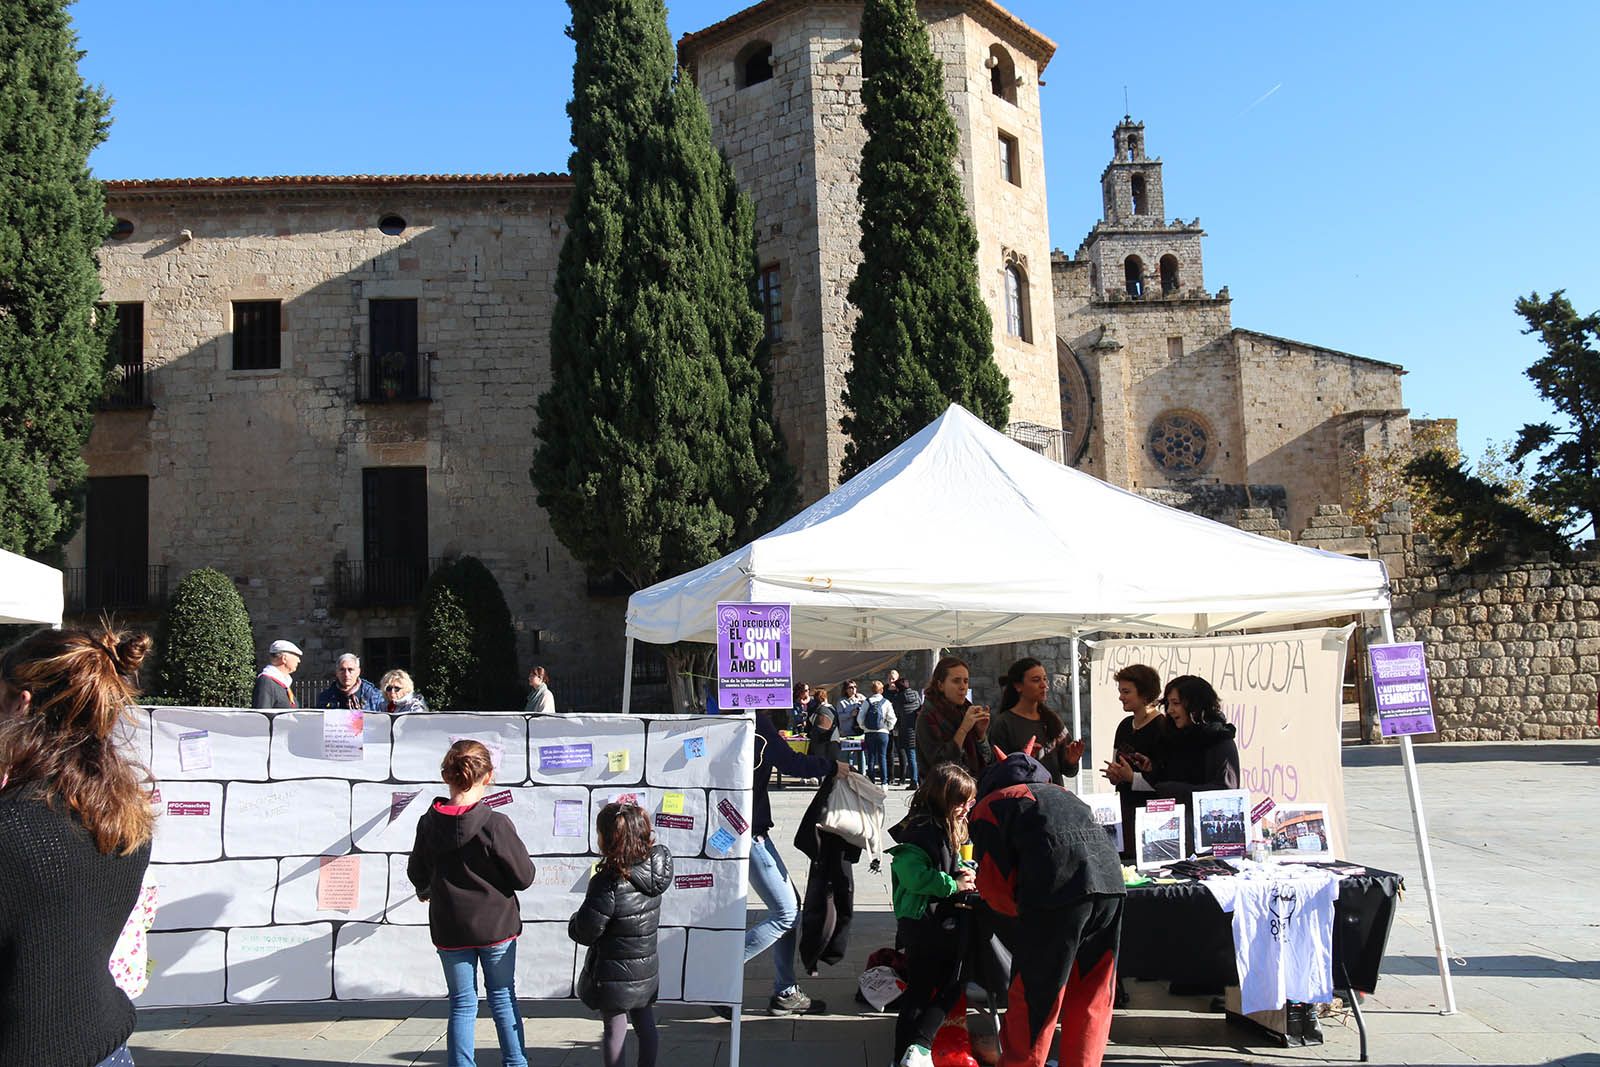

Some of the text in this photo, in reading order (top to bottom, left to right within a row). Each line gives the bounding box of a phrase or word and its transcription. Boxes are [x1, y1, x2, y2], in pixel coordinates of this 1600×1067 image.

[729, 619, 780, 628] JO DECIDEIXO
[729, 627, 781, 643] EL QUAN
[729, 641, 781, 660] L'ON I
[730, 660, 782, 675] AMB QUI
[1377, 682, 1427, 694] L'AUTODEFENSA
[1379, 690, 1428, 706] FEMINISTA
